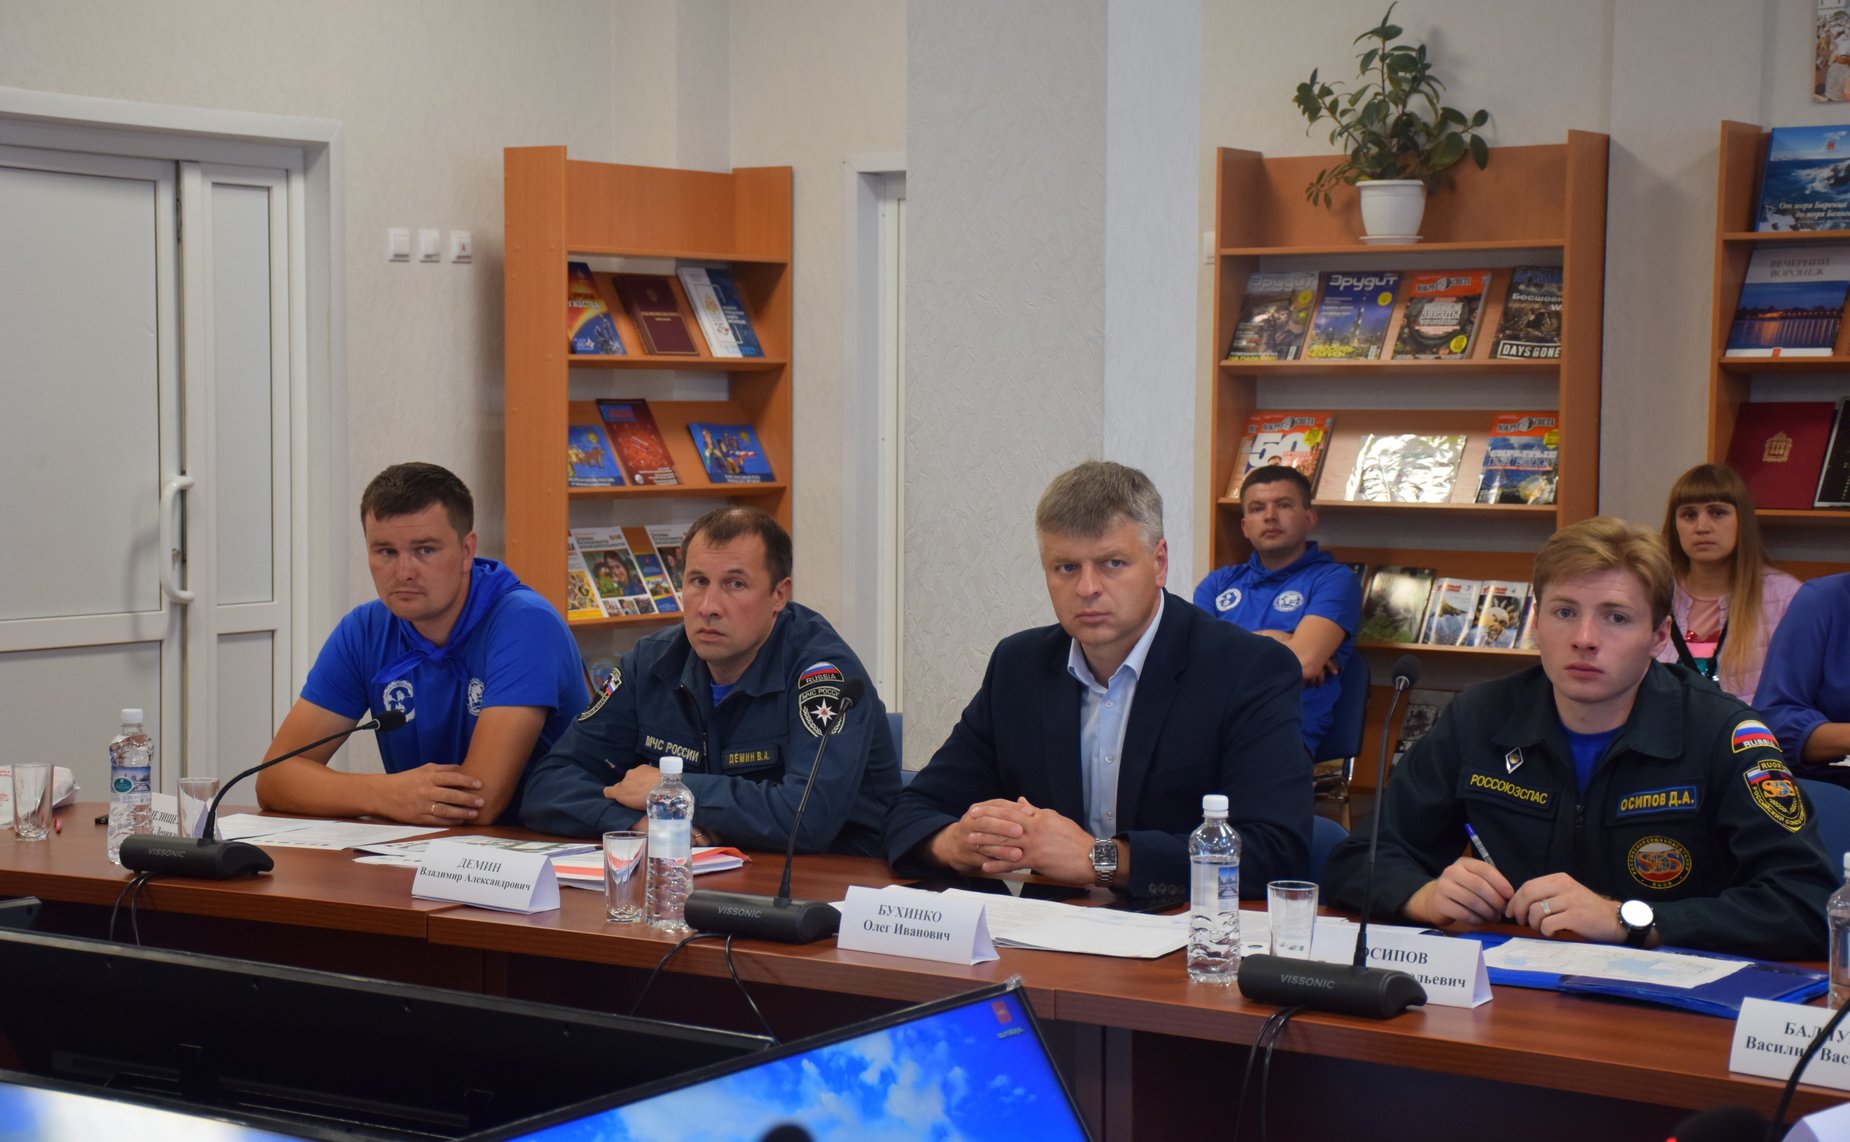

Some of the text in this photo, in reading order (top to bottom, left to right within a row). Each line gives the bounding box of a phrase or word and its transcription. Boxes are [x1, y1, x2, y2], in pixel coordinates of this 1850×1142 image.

[1329, 274, 1399, 291] Эрудит
[1503, 344, 1561, 359] DAYS GONE
[806, 673, 836, 684] RUSSIA
[802, 688, 840, 700] МЧС РОССИ
[645, 735, 700, 763] МЧС РОССИИ
[729, 752, 755, 767] ДЕМИН
[1470, 774, 1548, 804] РОССОЮЗСПАС
[1620, 790, 1695, 811] ОСИПОВ Д.А.
[148, 847, 186, 858] VISSONIC
[457, 858, 502, 873] ДЕМИН
[419, 866, 531, 891] Владимир Александрович
[718, 905, 762, 918] VISSONIC
[878, 904, 942, 923] БУХИНКО
[863, 919, 950, 941] Олег Иванович
[1366, 947, 1428, 965] СИПОВ
[1280, 974, 1336, 989] VISSONIC
